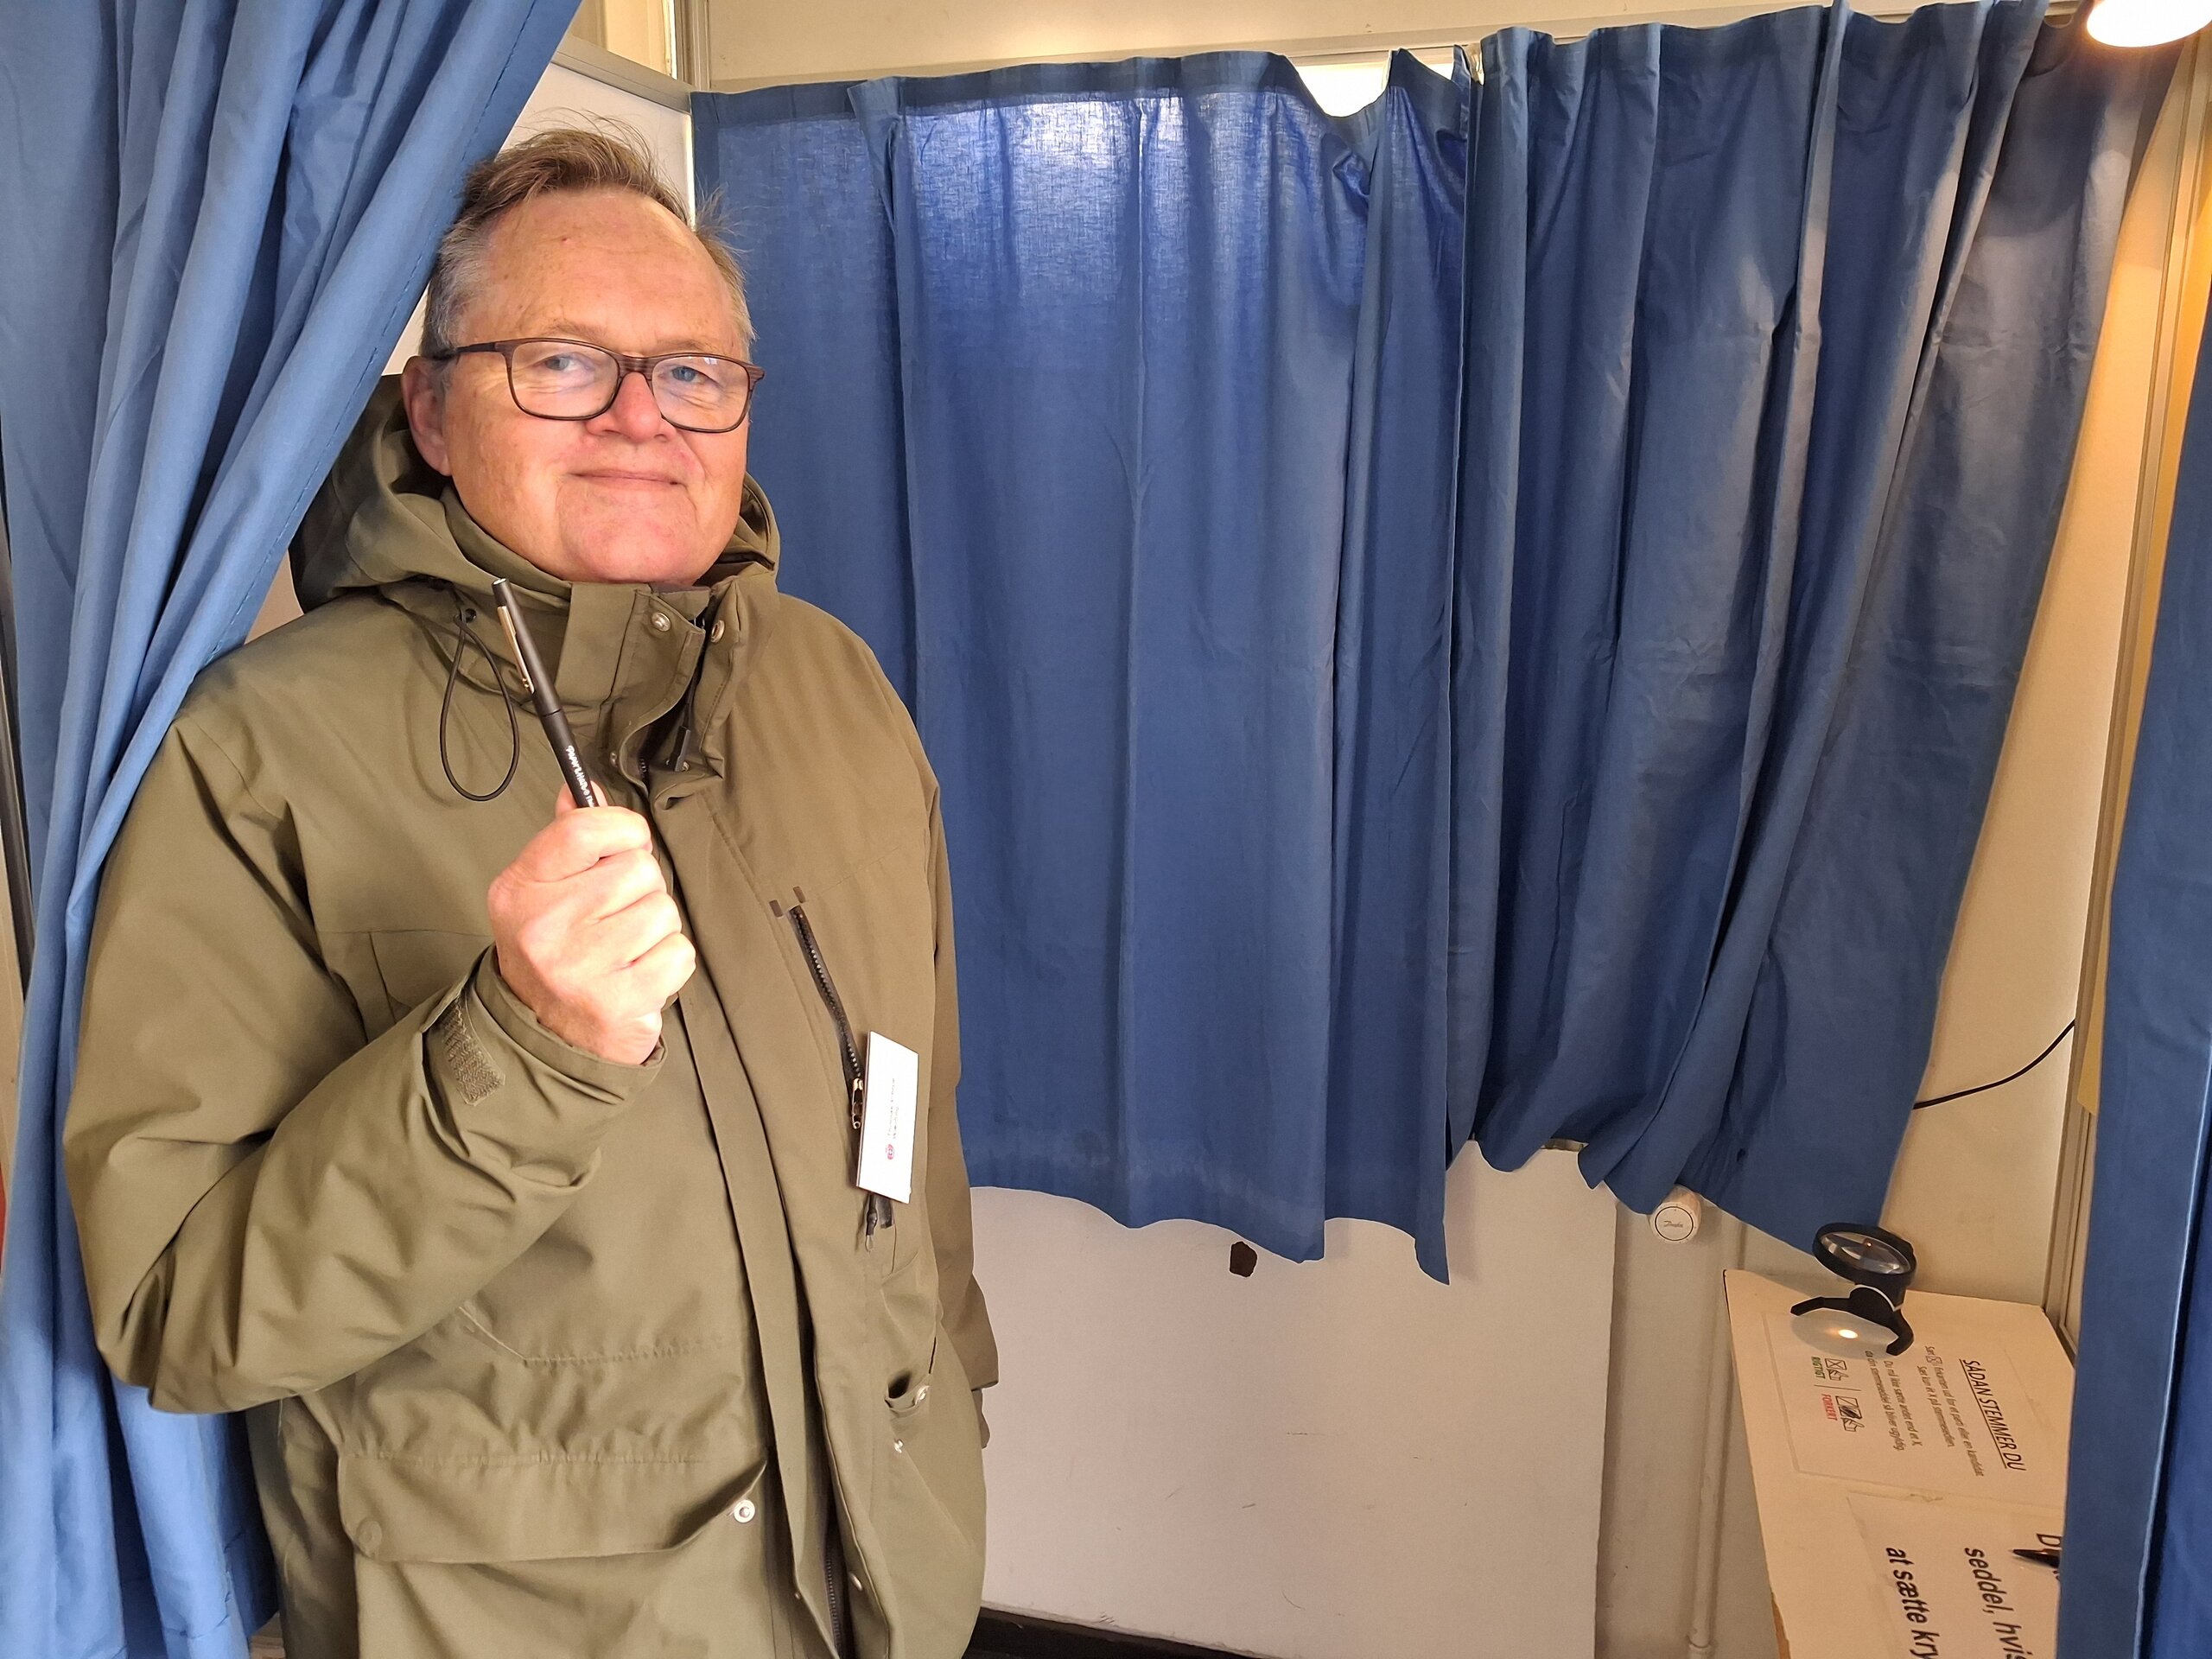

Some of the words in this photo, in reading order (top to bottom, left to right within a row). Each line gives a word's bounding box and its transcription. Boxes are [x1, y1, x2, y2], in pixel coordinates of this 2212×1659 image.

[1811, 1356, 1826, 1380] RIGTIGT
[1884, 1360, 1894, 1369] Du
[1821, 1393, 1838, 1421] FORKERT
[1962, 1359, 1994, 1397] SÅDAN
[1979, 1397, 2018, 1451] STEMMER
[2002, 1452, 2027, 1471] DU
[1886, 1547, 1915, 1565] at
[1964, 1547, 2014, 1614] seddel,
[1893, 1569, 1930, 1624] sætte
